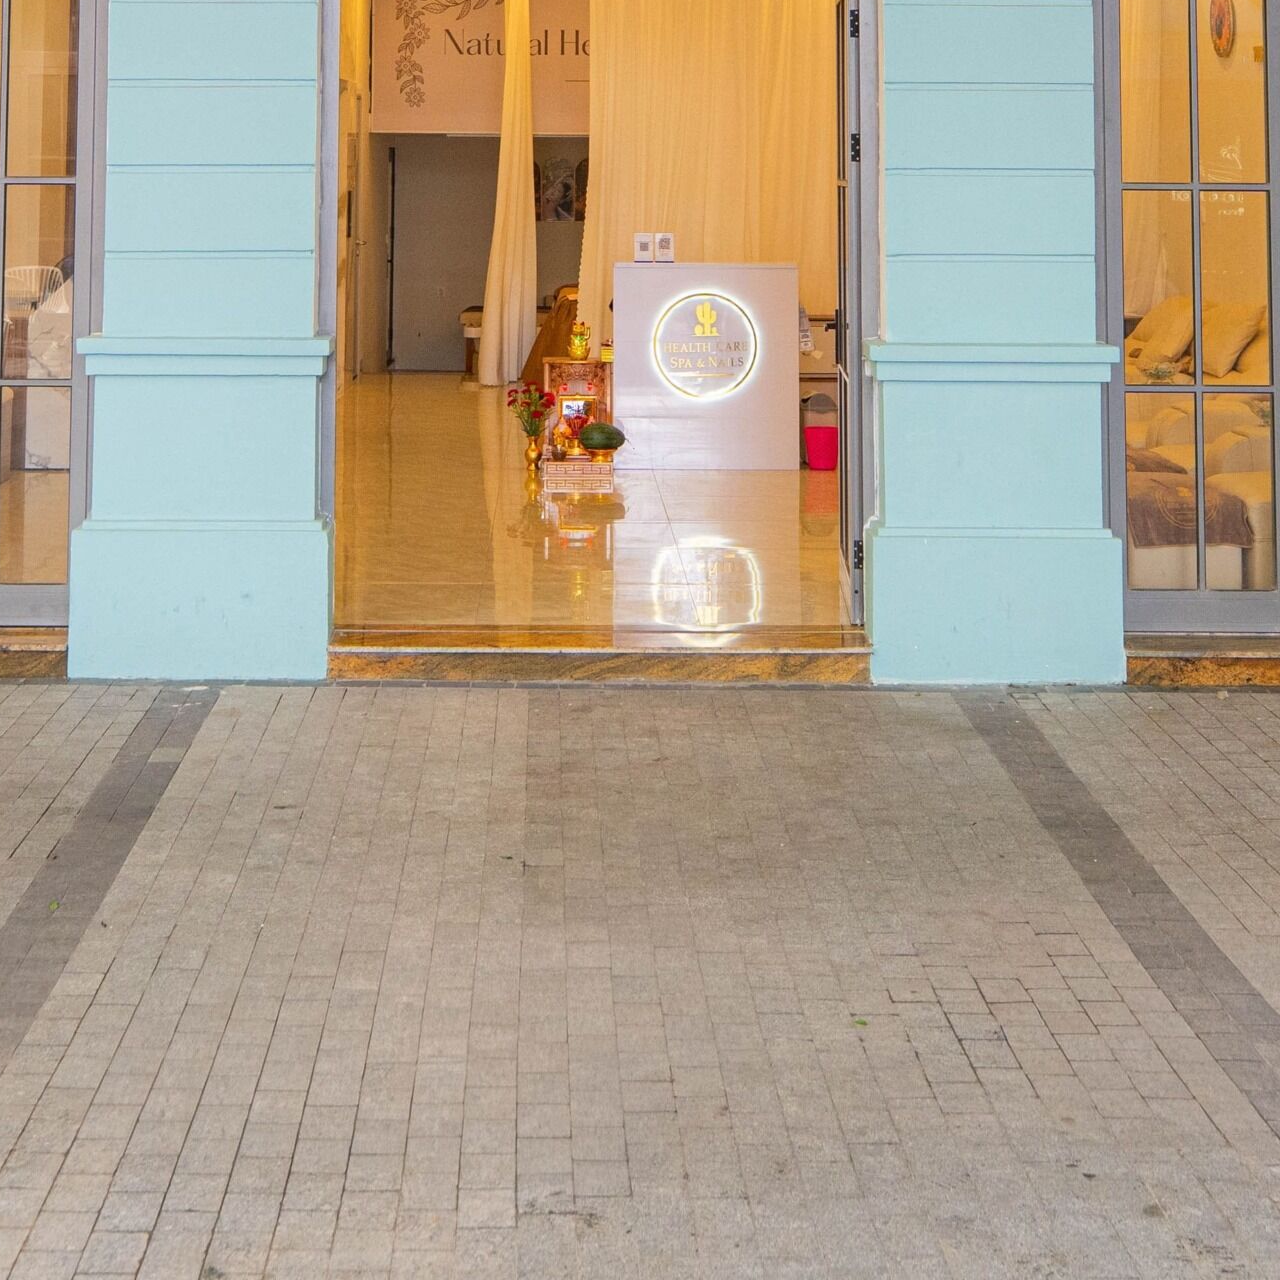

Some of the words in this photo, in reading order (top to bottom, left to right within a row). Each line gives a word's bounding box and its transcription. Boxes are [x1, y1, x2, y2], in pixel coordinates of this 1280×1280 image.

[438, 28, 549, 57] Natual
[663, 342, 711, 353] HEALTH
[696, 358, 705, 368] &
